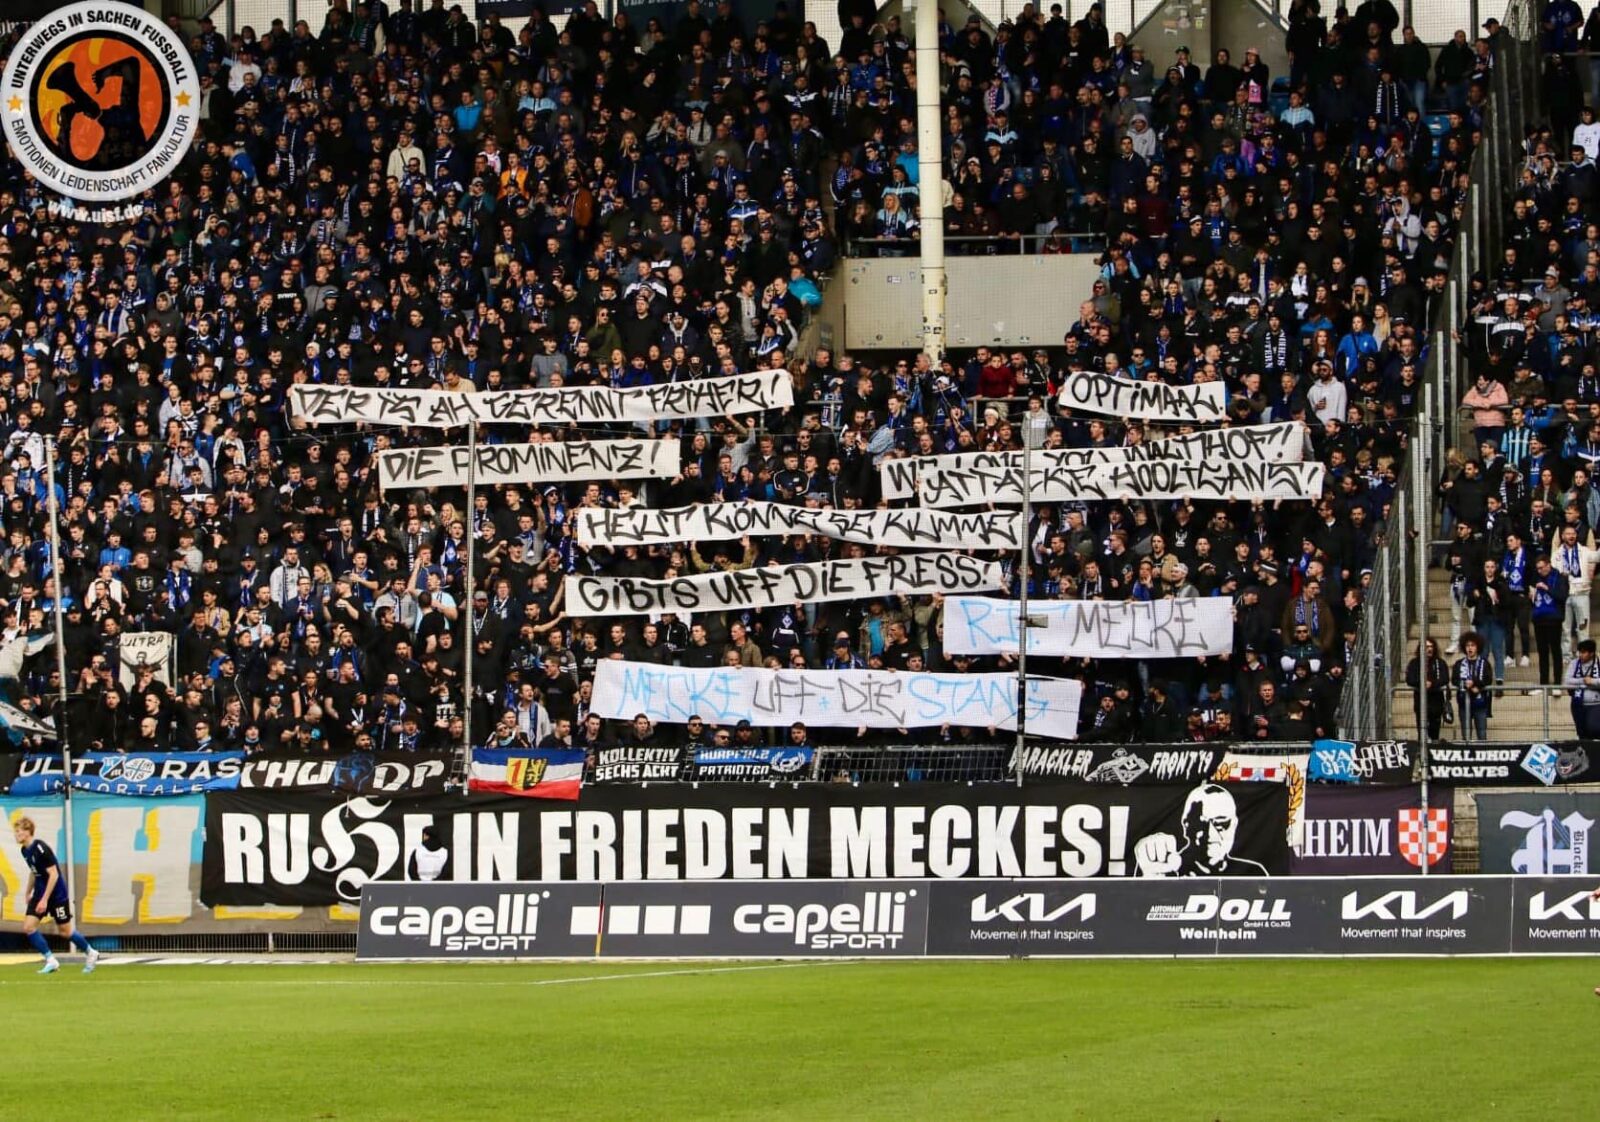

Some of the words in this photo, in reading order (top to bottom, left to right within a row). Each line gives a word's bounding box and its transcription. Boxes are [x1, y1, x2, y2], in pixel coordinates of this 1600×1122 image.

[585, 508, 693, 541] HEUT
[829, 510, 876, 539] SE
[711, 568, 785, 604] UFF
[864, 555, 990, 591] FRESS!
[1070, 600, 1208, 655] MECKE
[599, 748, 680, 764] KOLLEKTIV
[1430, 749, 1521, 761] WALDHOF
[596, 764, 640, 781] SECHS
[642, 765, 680, 778] ACHT
[1430, 765, 1509, 778] WOLVES
[453, 812, 519, 881] IN
[540, 807, 809, 881] FRIEDEN
[830, 804, 1130, 879] MECKES!
[55, 906, 66, 918] 15
[1184, 895, 1292, 921] DOLL
[370, 893, 540, 947] capelli
[733, 891, 907, 945] capelli
[1030, 929, 1051, 940] that
[1054, 929, 1094, 941] inspires
[1180, 928, 1257, 940] Weinheim
[1341, 927, 1398, 938] Movement
[1401, 927, 1423, 938] that
[1426, 927, 1467, 939] inspires
[1529, 927, 1587, 938] Movement
[445, 936, 536, 951] SPORT
[811, 935, 903, 949] SPORT
